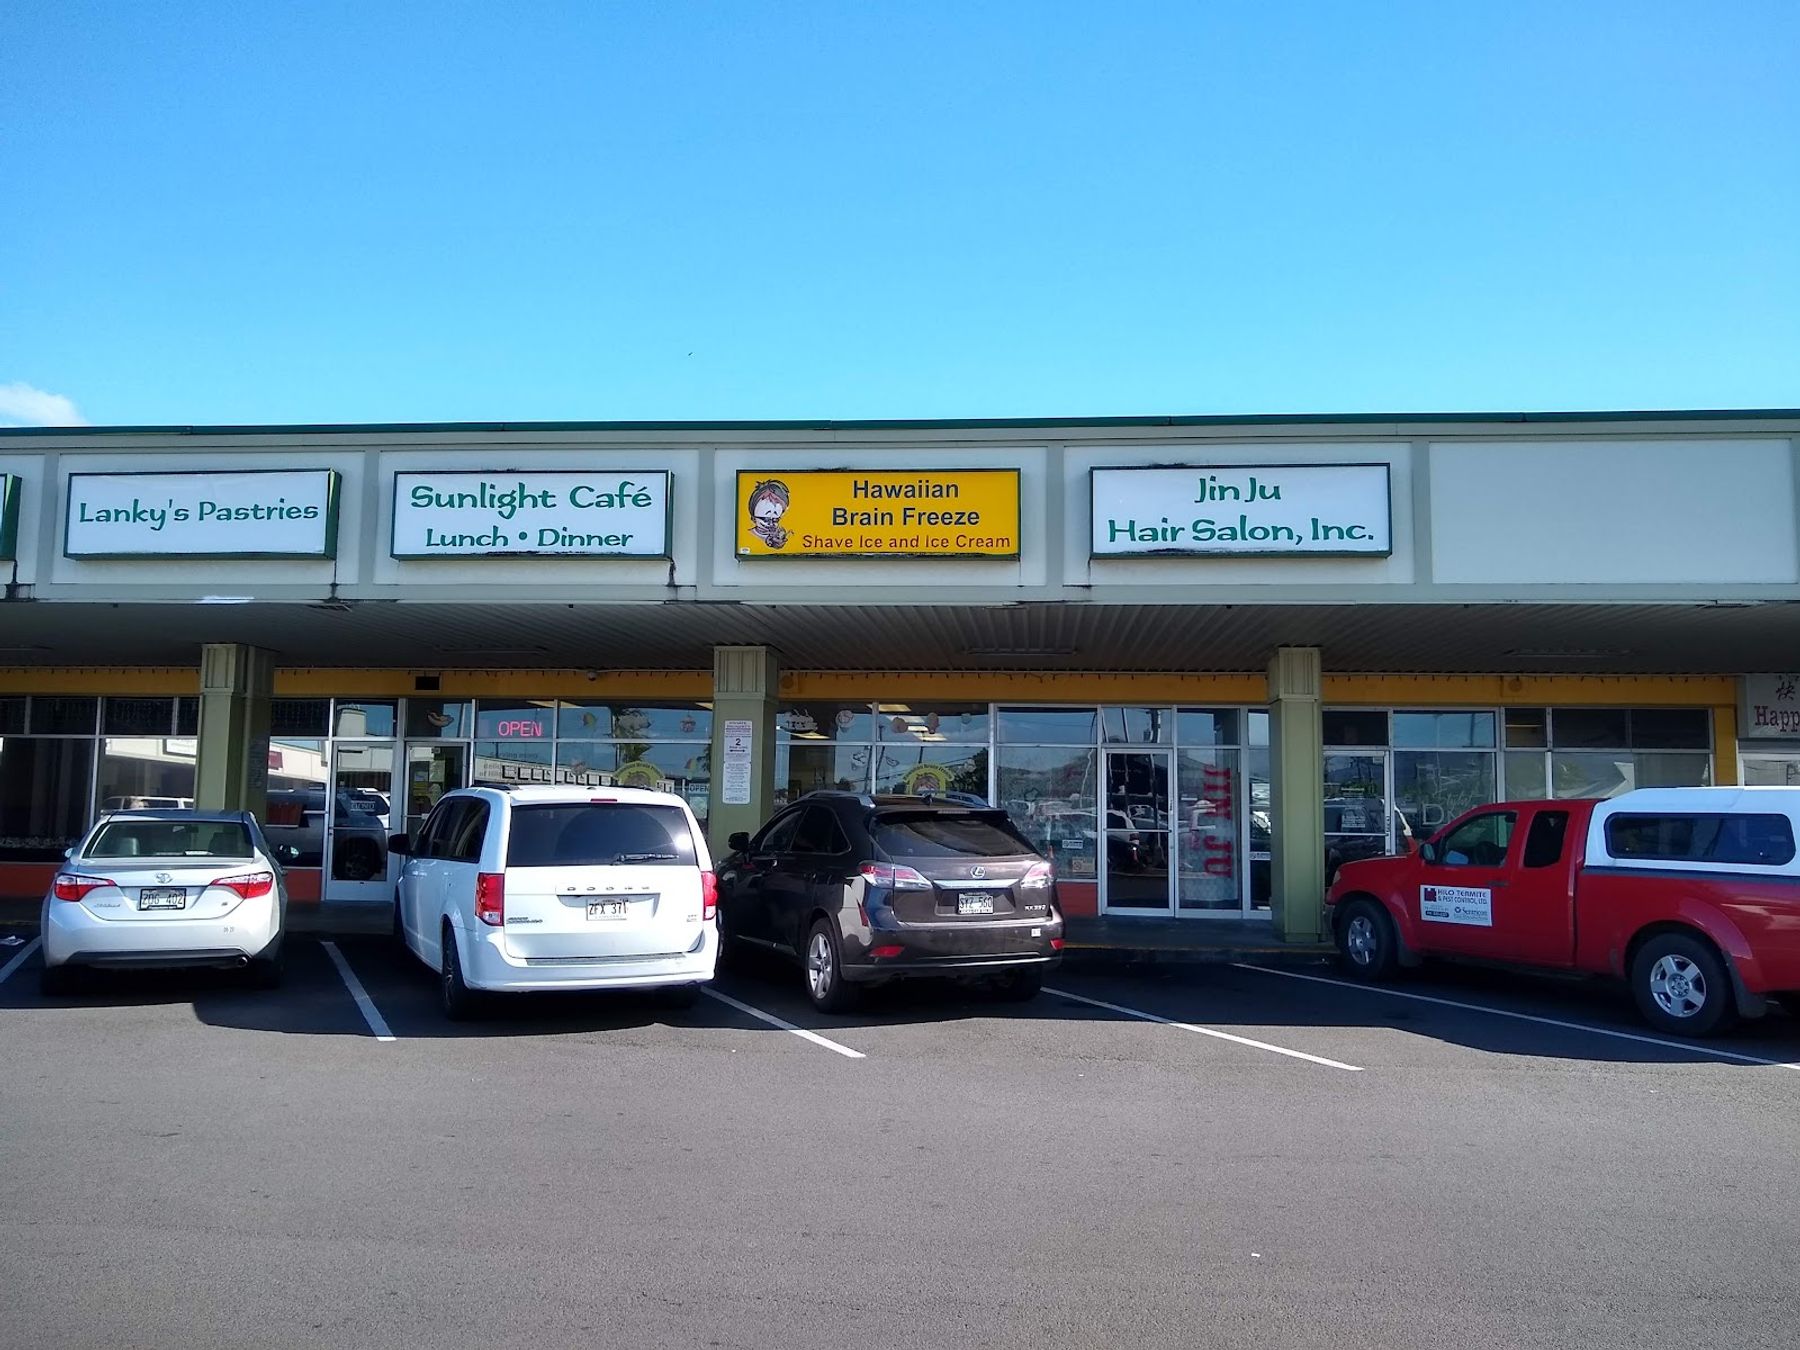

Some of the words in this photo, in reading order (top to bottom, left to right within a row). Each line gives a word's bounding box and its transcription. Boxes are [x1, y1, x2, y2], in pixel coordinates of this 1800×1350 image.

[853, 480, 959, 499] Hawaiian
[1194, 475, 1240, 503] Jin
[1244, 477, 1281, 502] Ju
[410, 482, 557, 520] Sunlight
[569, 480, 652, 509] Café
[79, 498, 189, 531] Lanky's
[198, 498, 319, 521] Pastries
[832, 507, 893, 526] Brain
[903, 508, 980, 526] Freeze
[426, 525, 509, 547] Lunch
[538, 527, 633, 547] Dinner
[1108, 517, 1185, 543] Hair
[1192, 514, 1303, 546] Salon,
[1310, 517, 1374, 541] Inc.
[802, 535, 853, 549] Shave
[859, 535, 882, 548] Ice
[889, 535, 912, 548] and
[926, 535, 949, 548] Ice
[955, 535, 1010, 548] Cream
[498, 720, 542, 737] OPEN
[735, 738, 741, 746] 2
[1203, 835, 1232, 878] JU
[166, 893, 183, 905] 402
[1438, 888, 1455, 896] HILO
[1457, 890, 1486, 898] TERMITE
[589, 902, 606, 916] ZFX
[611, 901, 628, 915] 371
